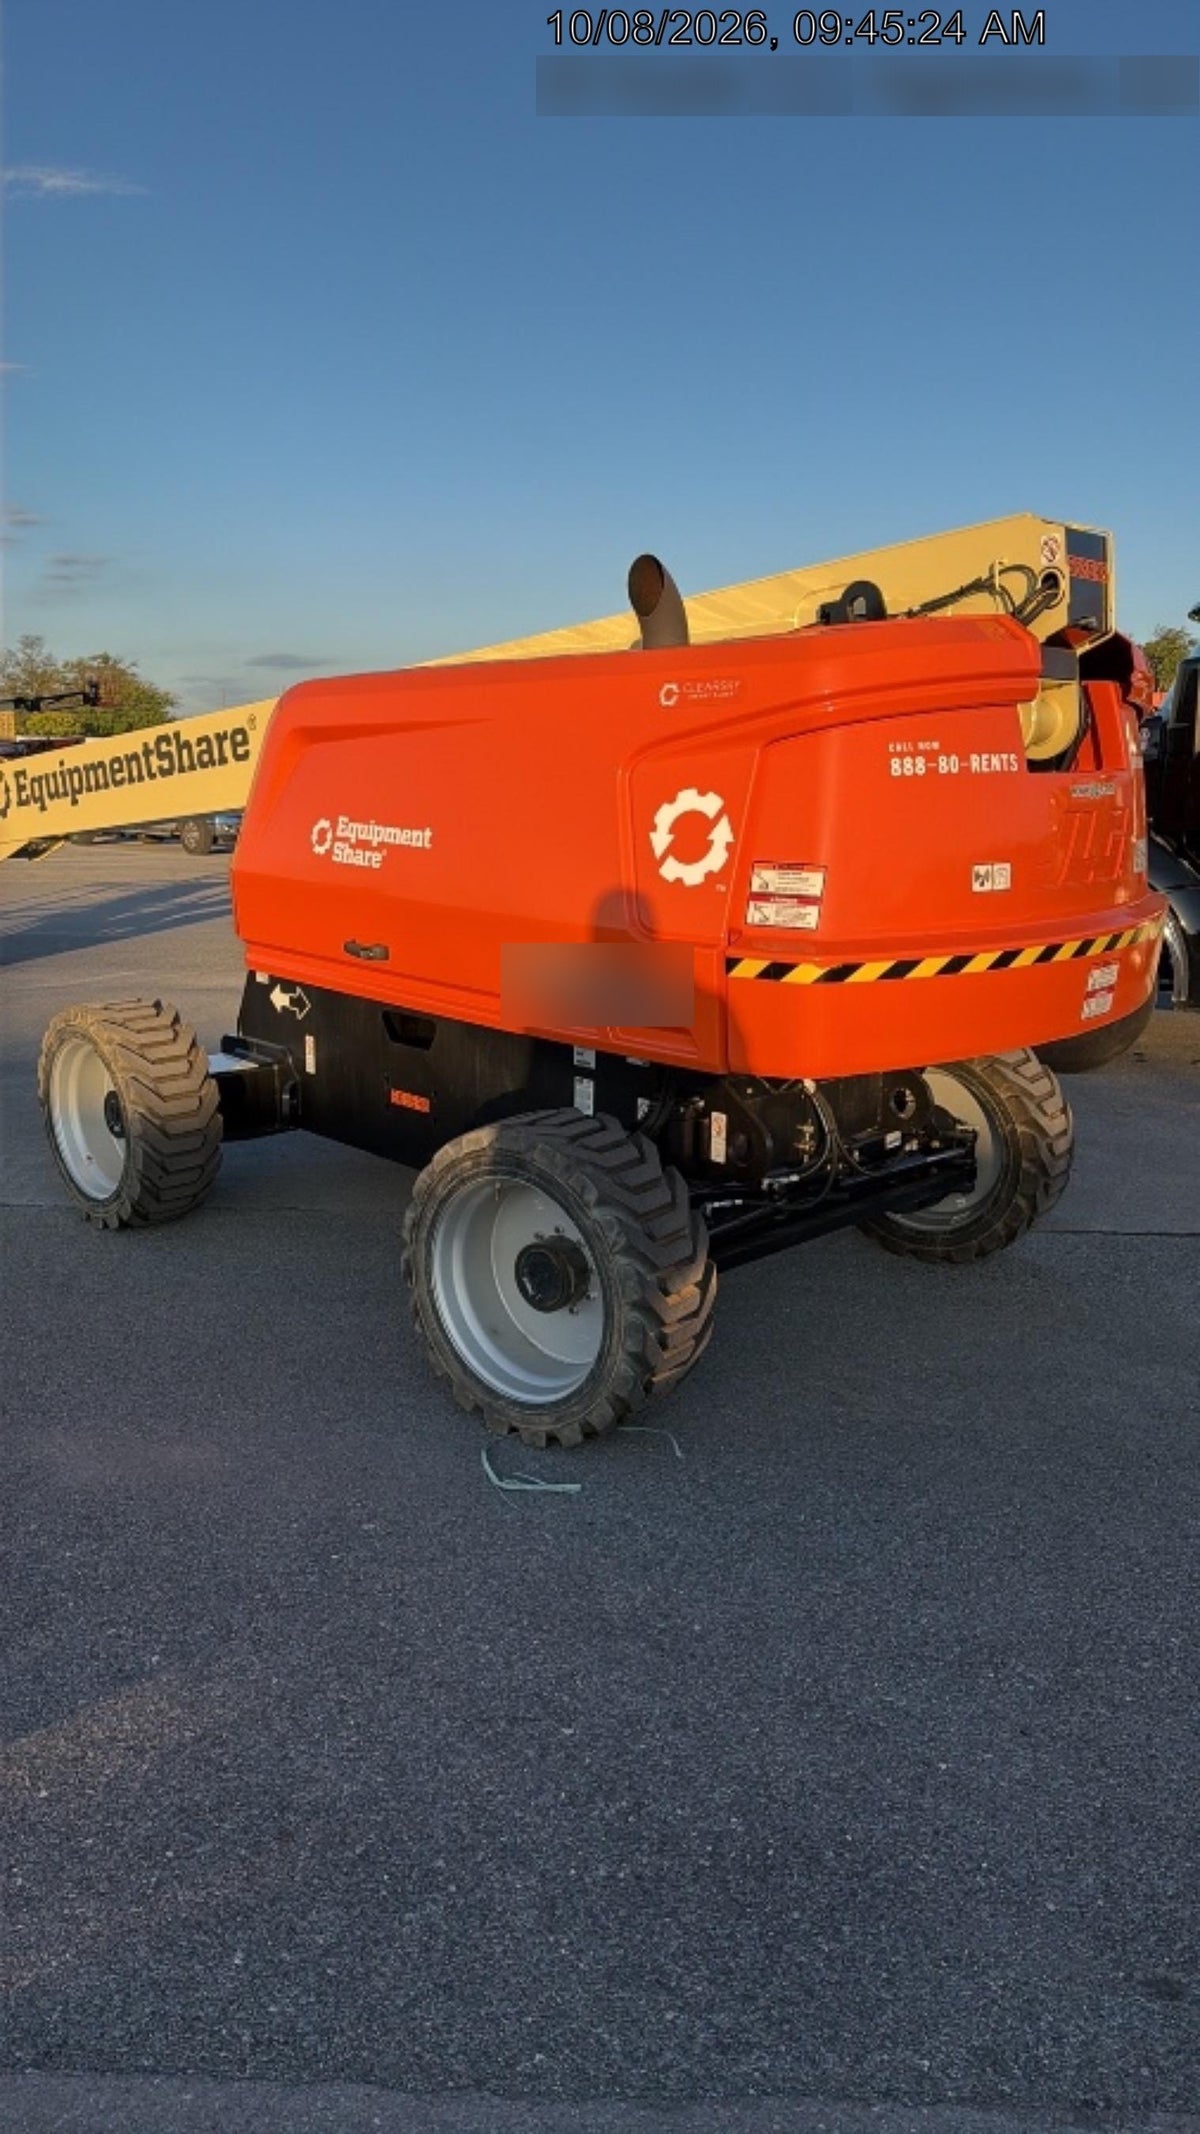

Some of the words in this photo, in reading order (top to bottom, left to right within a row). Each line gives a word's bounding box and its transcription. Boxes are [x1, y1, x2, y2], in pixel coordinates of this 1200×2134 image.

[888, 741, 914, 753] CALL
[917, 740, 940, 751] NOW
[890, 753, 1019, 776] 888-80-RENTS
[336, 815, 433, 849] Equipment
[331, 841, 383, 869] Share
